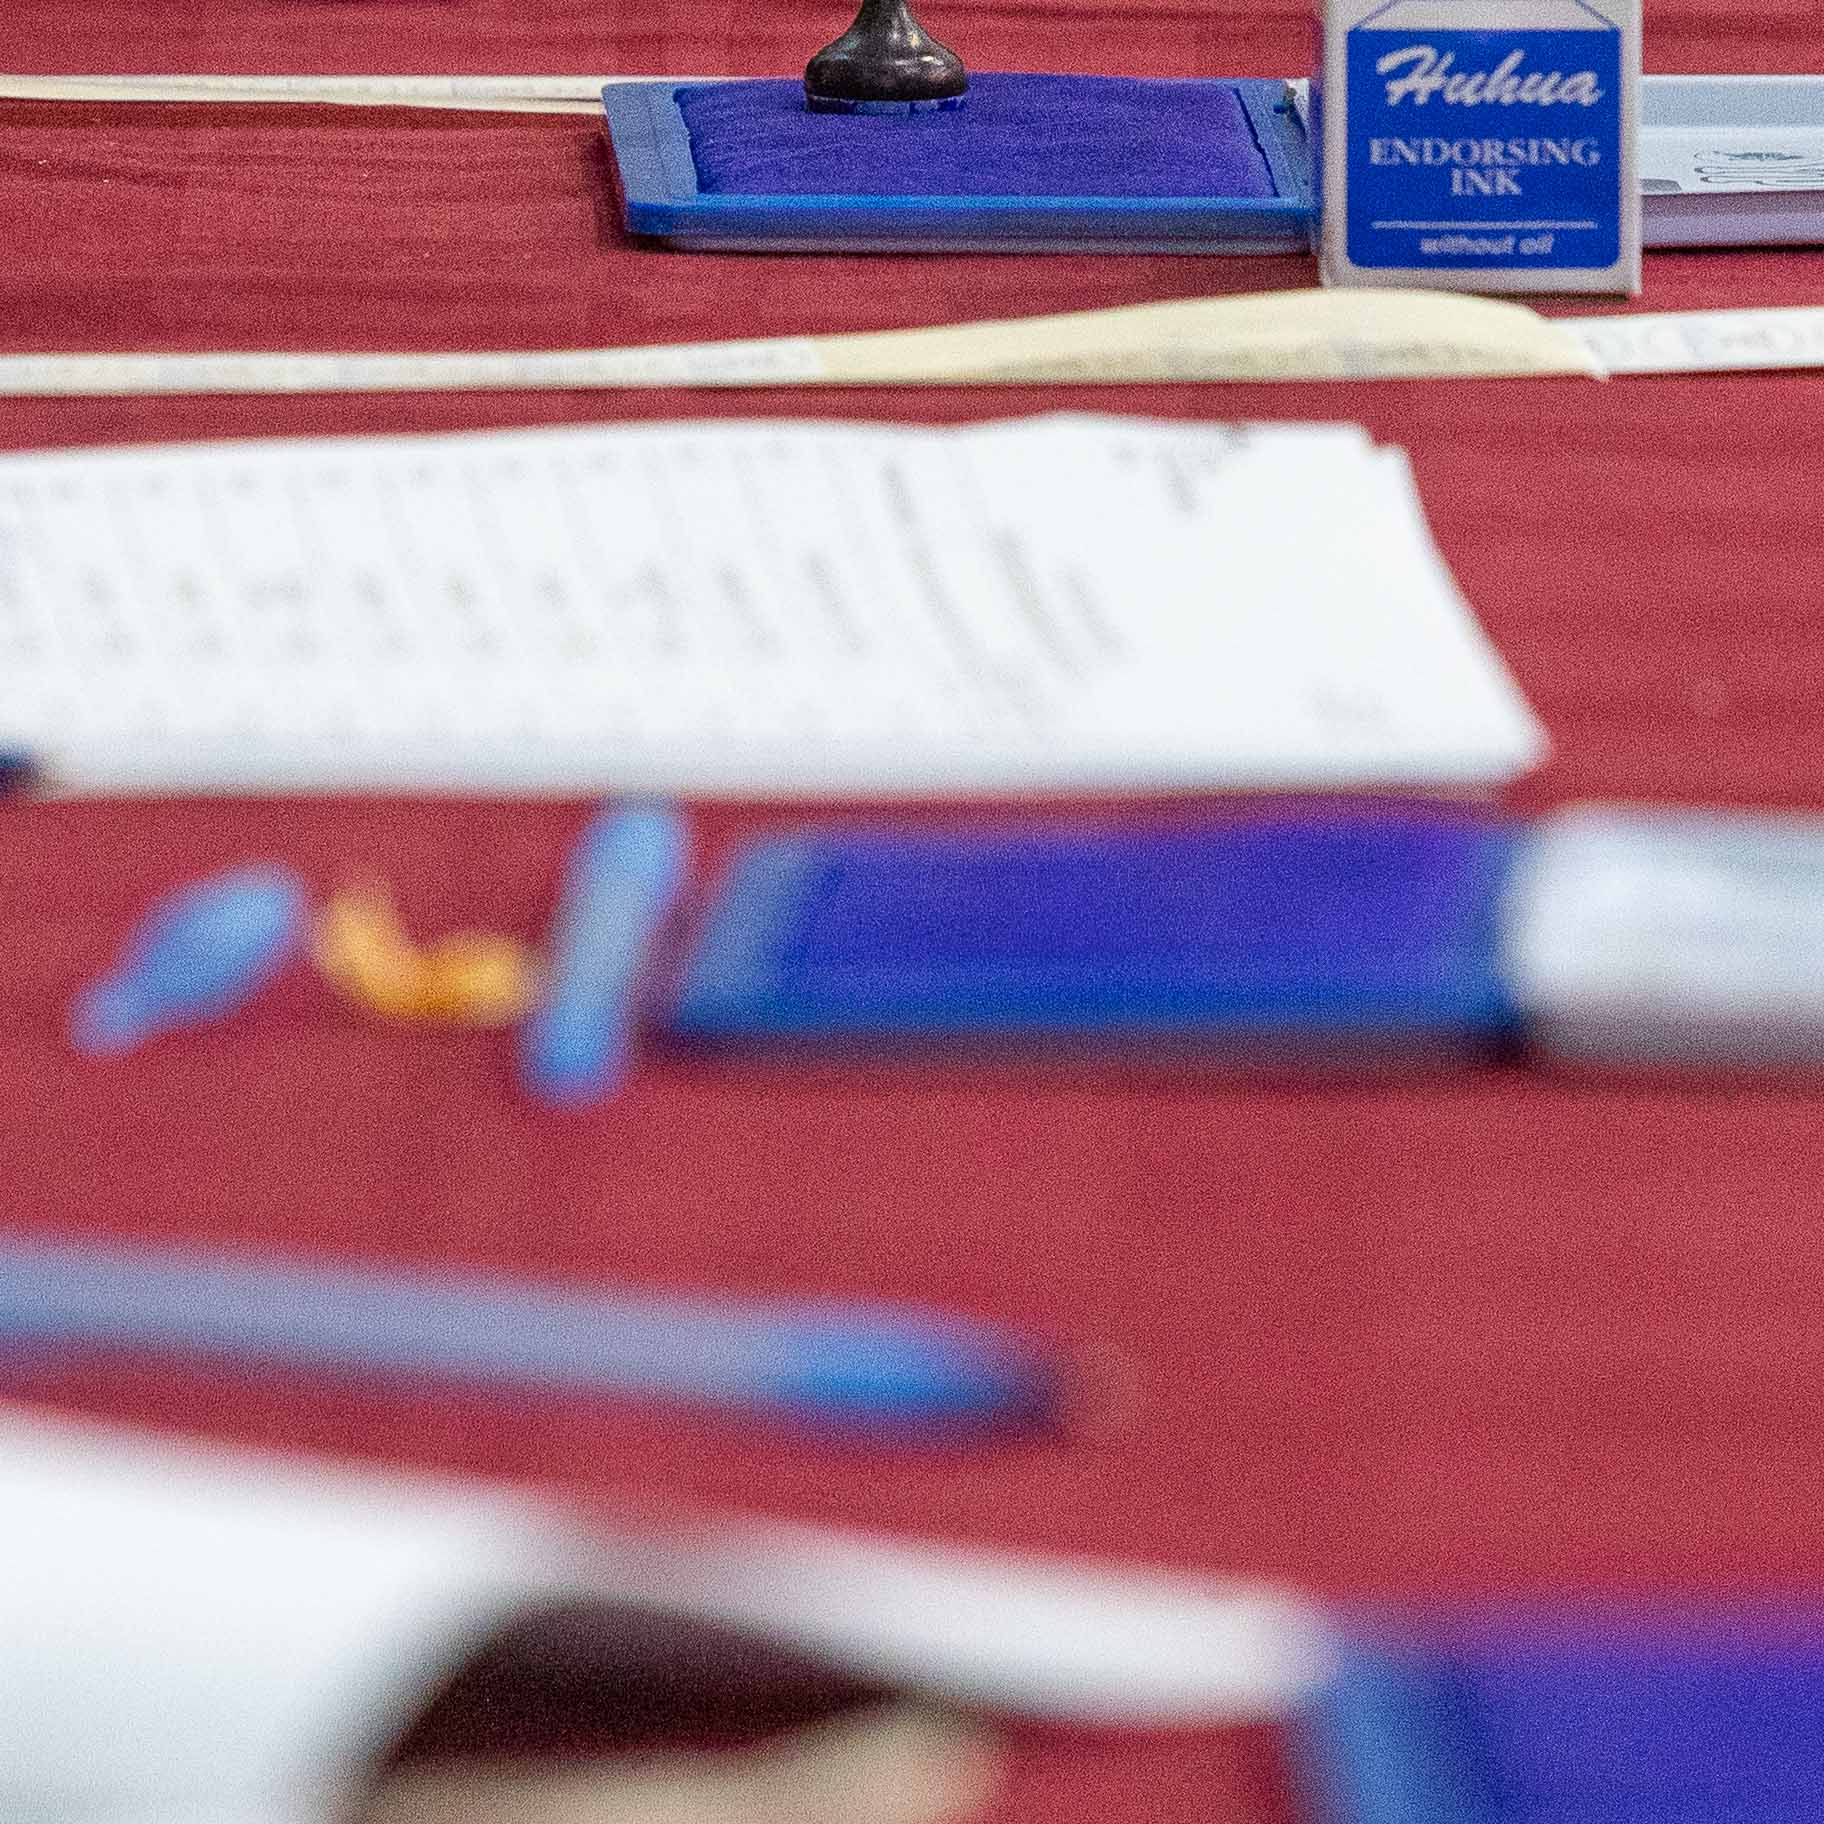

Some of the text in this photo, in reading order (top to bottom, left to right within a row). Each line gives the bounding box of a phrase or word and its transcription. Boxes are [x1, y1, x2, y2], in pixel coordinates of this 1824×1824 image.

[1376, 44, 1604, 107] Huhua
[1369, 137, 1602, 167] ENDORSING
[1451, 168, 1523, 197] INK
[1420, 233, 1554, 255] without oil
